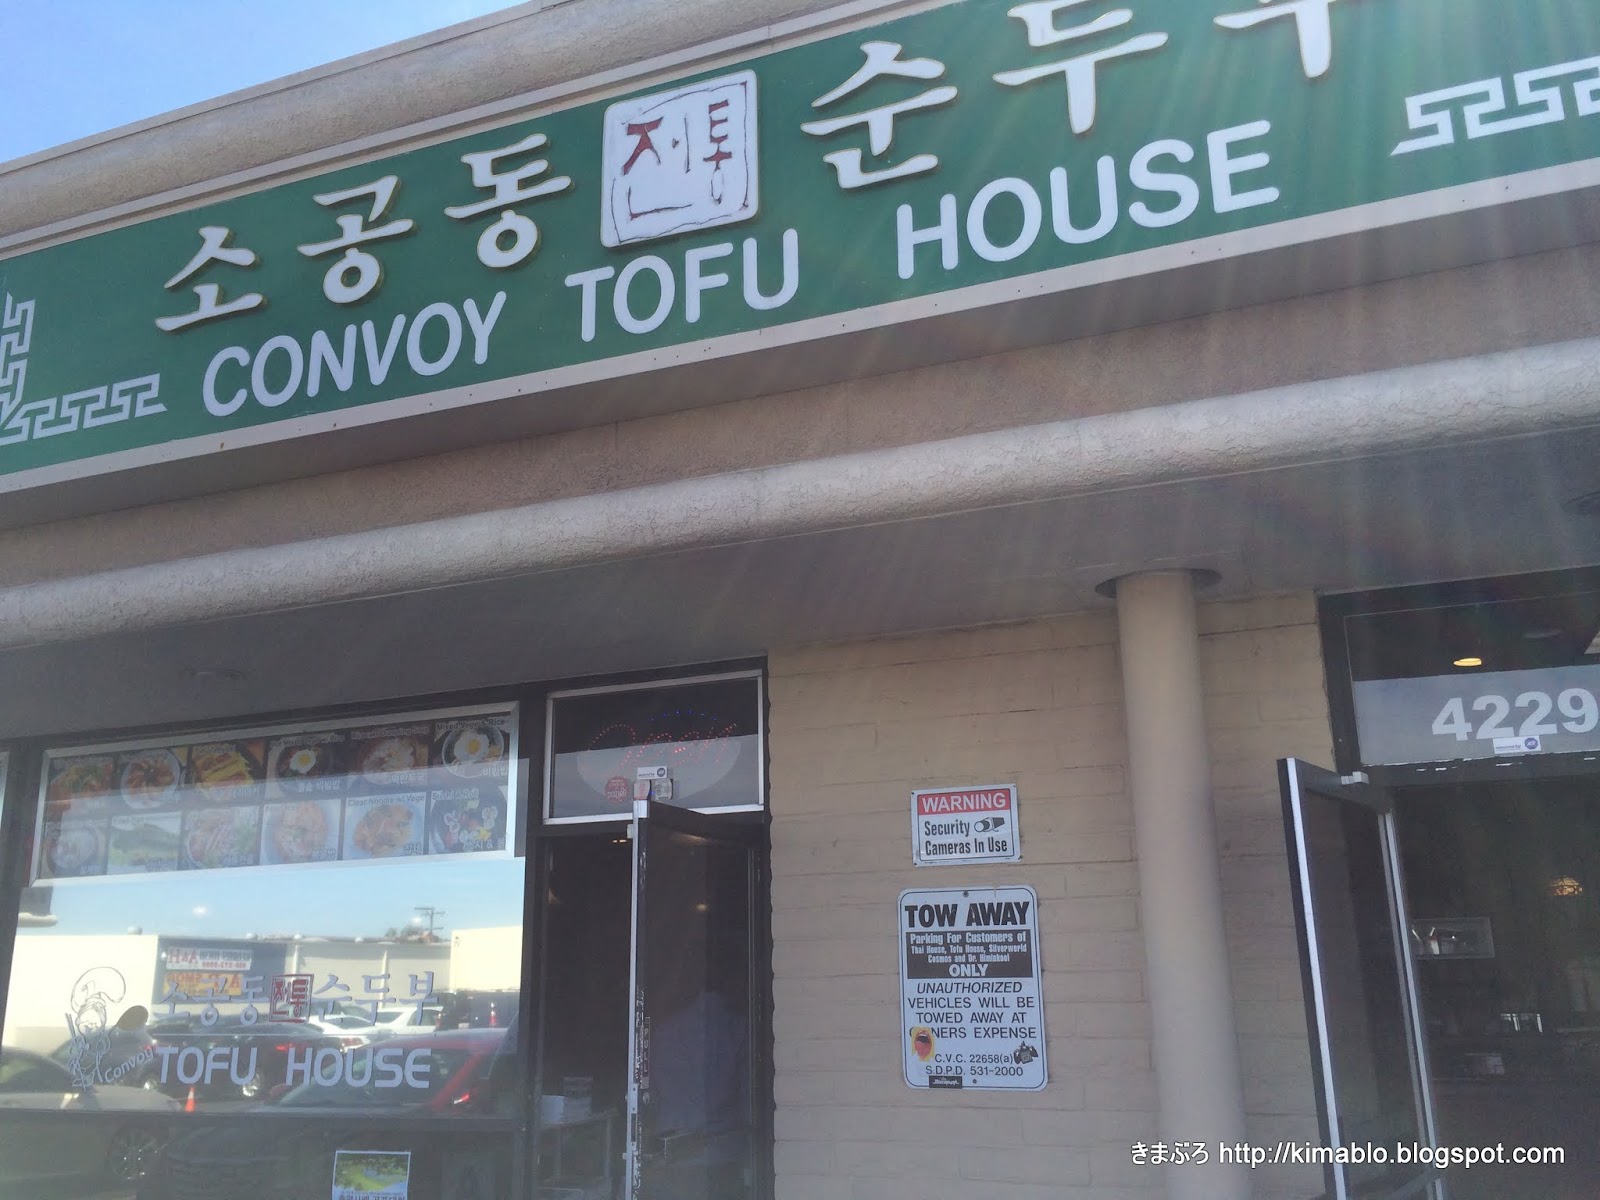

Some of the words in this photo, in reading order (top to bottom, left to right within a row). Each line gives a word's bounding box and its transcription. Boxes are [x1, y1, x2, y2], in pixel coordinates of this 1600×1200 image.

[155, 133, 573, 332] 소공동
[203, 290, 507, 417] CONVOY
[564, 228, 800, 342] TOFU
[896, 119, 1280, 280] HOUSE
[1431, 687, 1599, 741] 4229
[489, 718, 506, 727] Rice
[922, 792, 1006, 813] WARNING
[924, 819, 970, 837] Security
[925, 840, 971, 856] Cameras
[975, 838, 985, 853] In
[988, 836, 1008, 852] Use
[904, 903, 958, 928] TOW
[966, 901, 1029, 926] AWAY
[910, 933, 943, 945] Parking
[947, 932, 962, 944] For
[966, 932, 1013, 943] Customers
[1017, 931, 1026, 943] of
[911, 945, 924, 954] Thai
[927, 945, 947, 955] House,
[950, 944, 963, 954] Tofu
[965, 944, 986, 954] House,
[928, 954, 952, 964] Cosmos
[955, 953, 966, 963] and
[968, 953, 977, 963] Dr.
[948, 963, 989, 977] ONLY
[917, 981, 1023, 994] UNAUTHORIZED
[152, 974, 269, 1027] 소공동
[908, 997, 971, 1009] VEHICLES
[979, 997, 1010, 1008] WILL
[1017, 996, 1035, 1008] BE
[916, 1012, 963, 1023] TOWED
[970, 1012, 1004, 1023] AWAY
[1011, 1012, 1027, 1023] AT
[909, 1027, 967, 1039] NERS
[974, 1027, 1037, 1039] EXPENSE
[934, 1053, 966, 1064] C.V.C.
[969, 1053, 1014, 1065] 22658(a)
[105, 1049, 154, 1083] Convoy
[156, 1047, 258, 1086] TOFU
[285, 1047, 432, 1089] HOUSE
[925, 1065, 966, 1076] S.D.P.D.
[970, 1066, 1024, 1077] 531-2000
